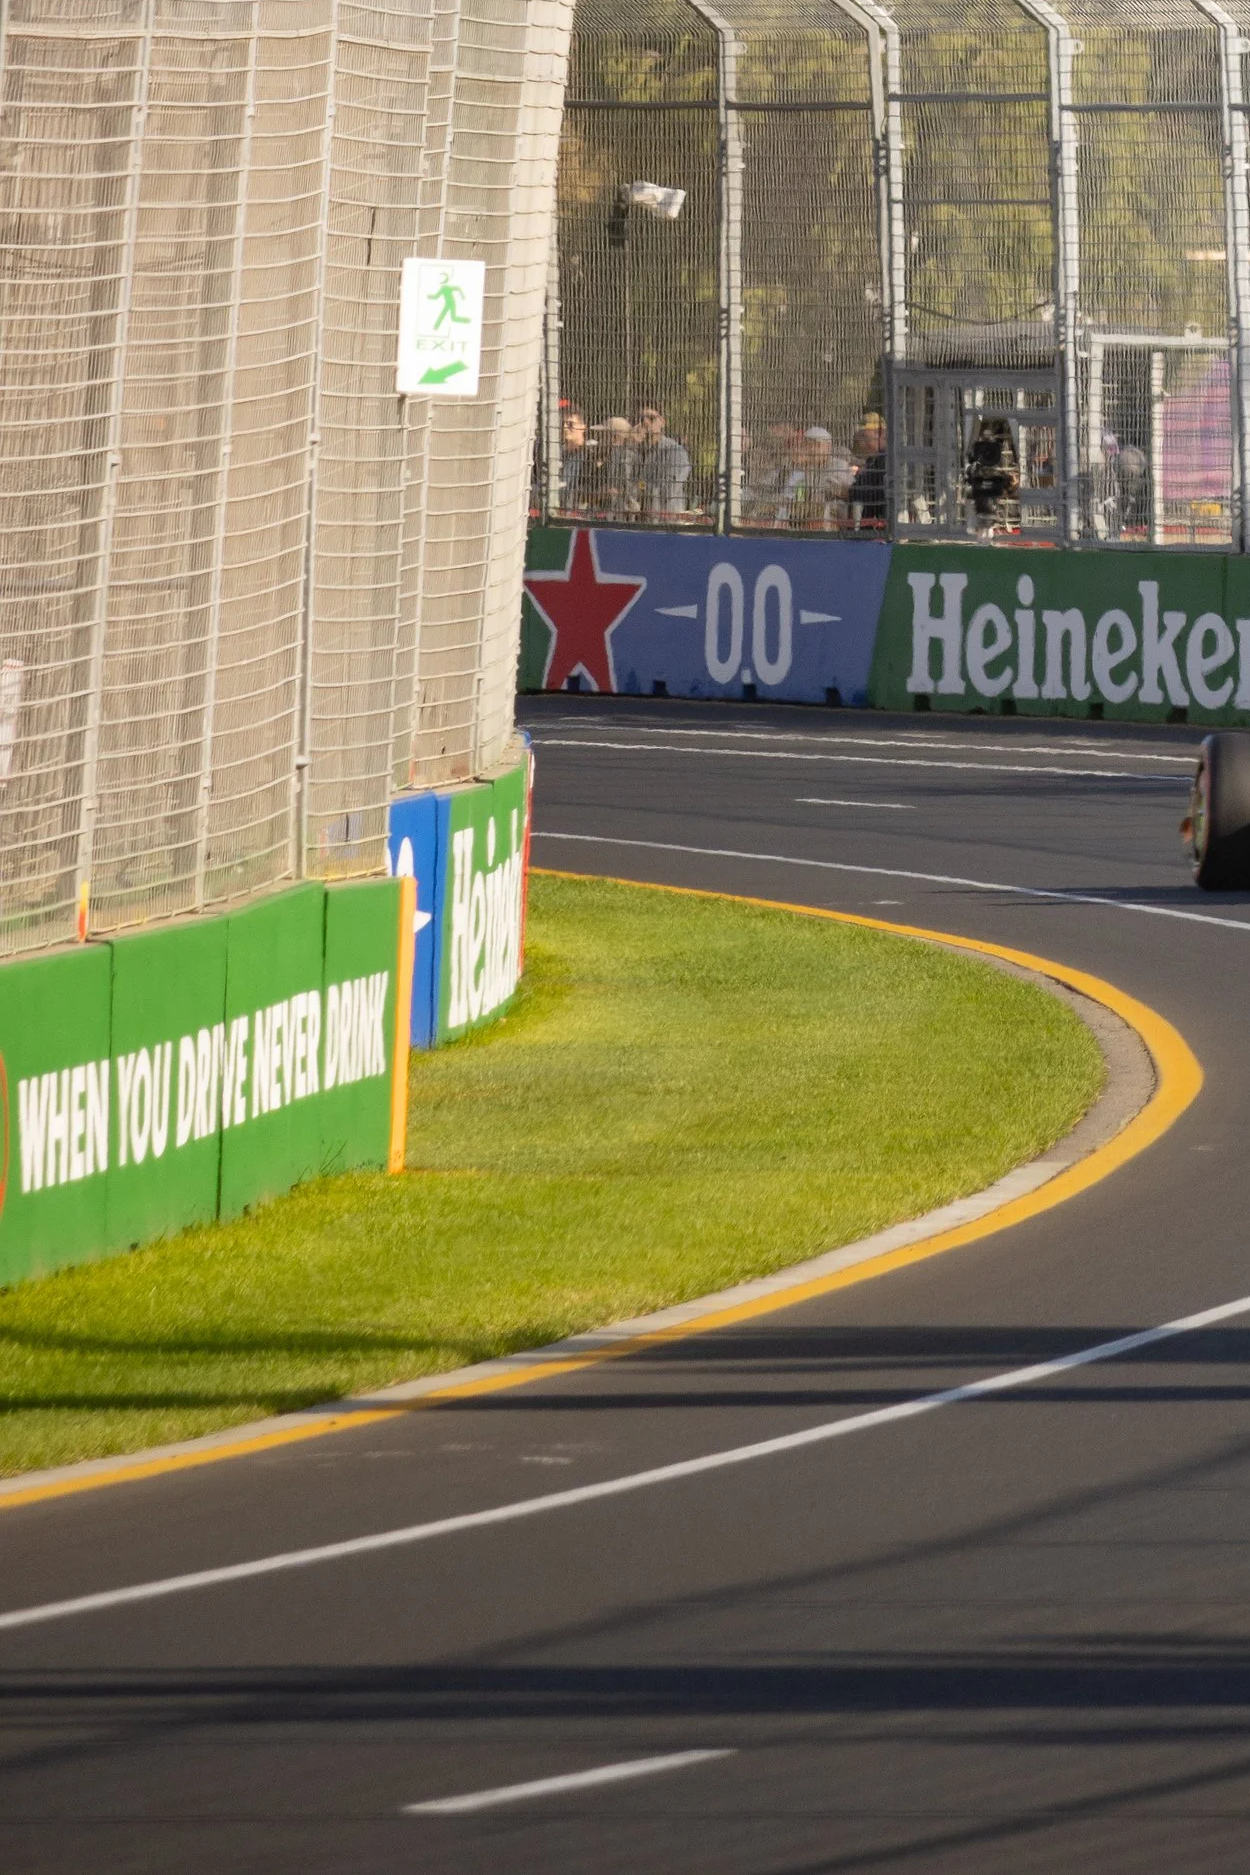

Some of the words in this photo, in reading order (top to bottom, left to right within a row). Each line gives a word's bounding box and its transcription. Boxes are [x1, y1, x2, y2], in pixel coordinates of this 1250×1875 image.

[416, 339, 470, 353] EXIT
[18, 1059, 110, 1194] WHEN
[117, 1041, 173, 1168] YOU
[176, 1014, 249, 1149] DRIVE
[252, 989, 321, 1119] NEVER
[324, 970, 389, 1090] DRINK
